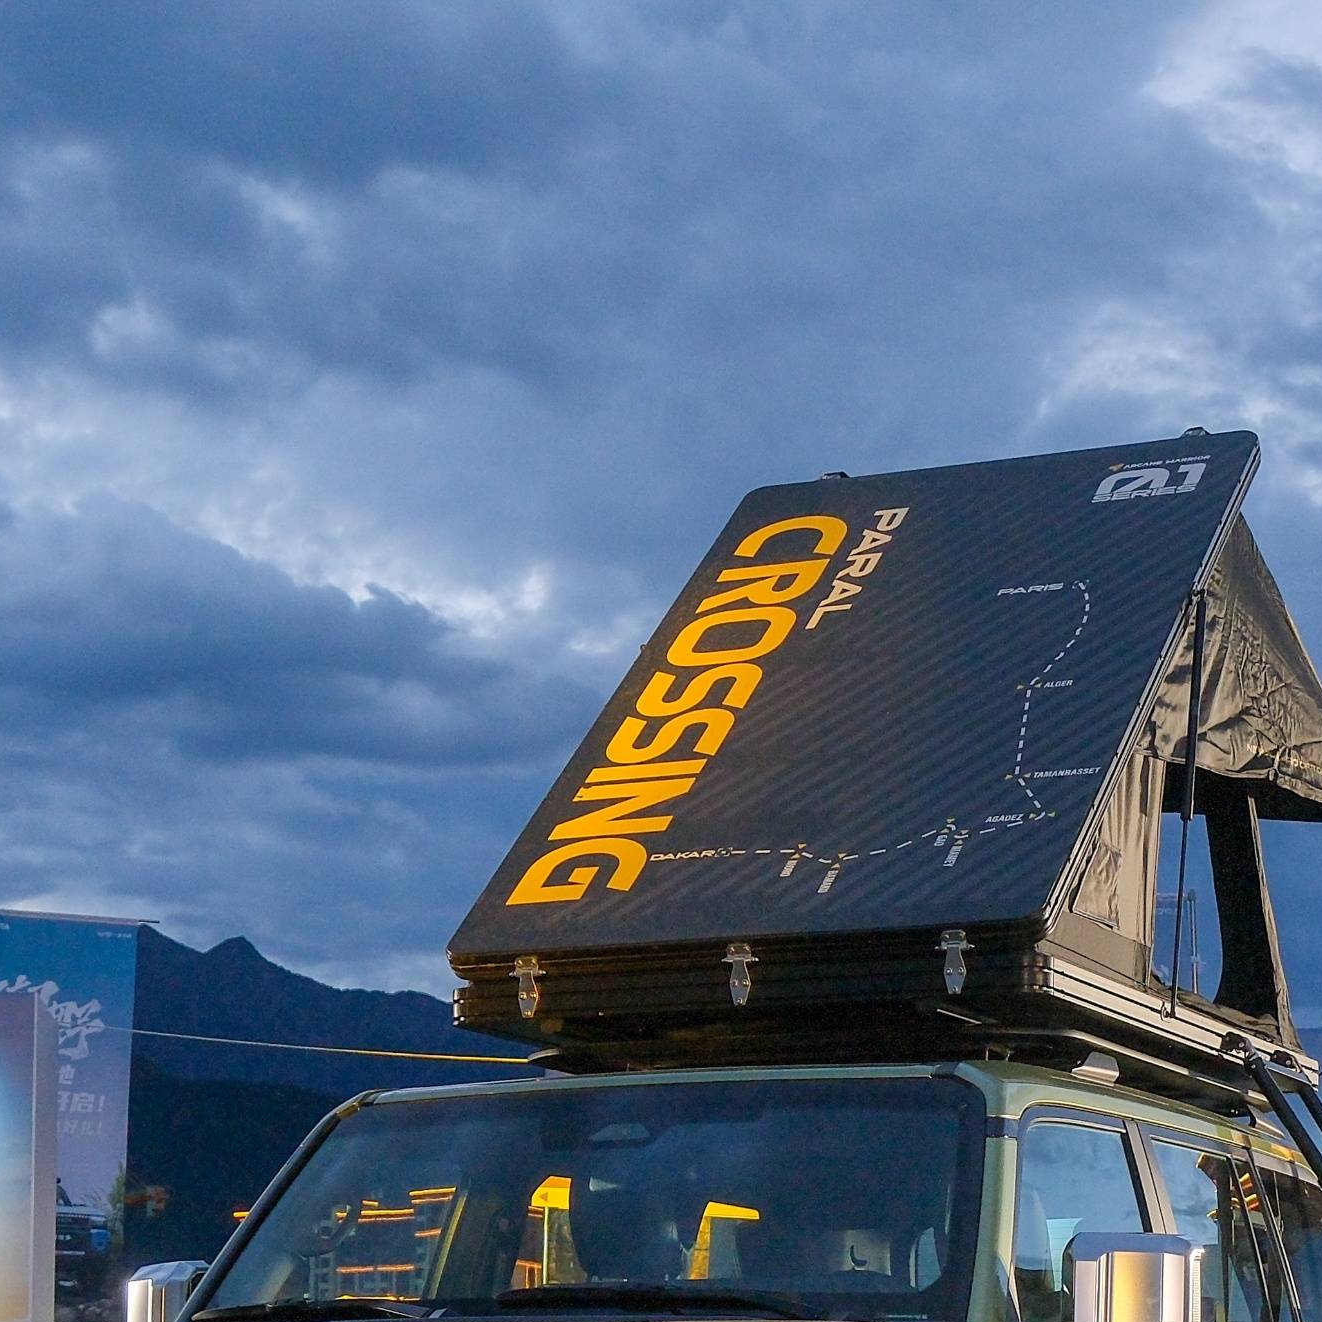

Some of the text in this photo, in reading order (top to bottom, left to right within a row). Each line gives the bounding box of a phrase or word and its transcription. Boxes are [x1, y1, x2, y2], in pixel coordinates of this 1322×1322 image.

[1091, 484, 1198, 503] SERIES
[805, 506, 909, 630] PARAL
[997, 582, 1065, 596] PARIS
[1043, 679, 1074, 689] ALGER
[505, 515, 848, 906] CROSSING
[985, 813, 1025, 824] AGADEZ
[649, 849, 716, 862] DAKAR
